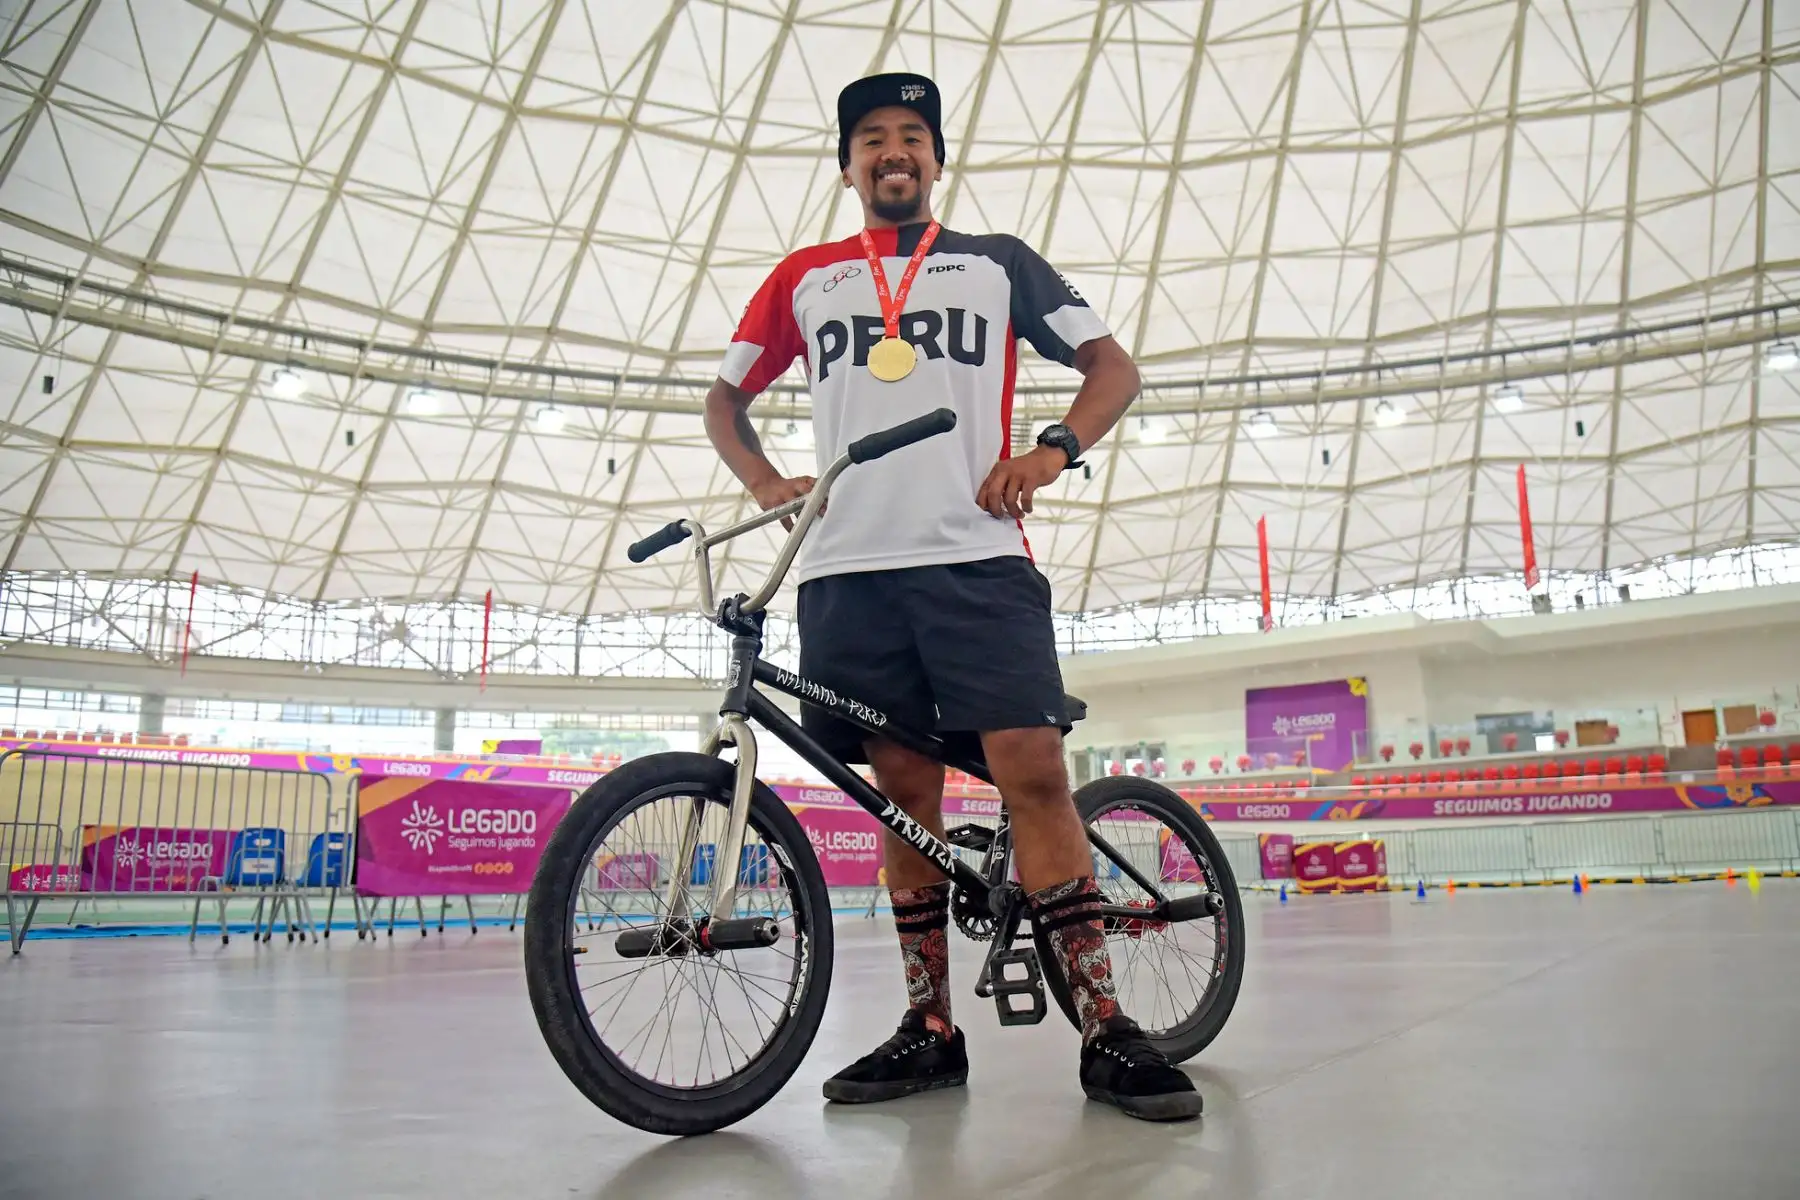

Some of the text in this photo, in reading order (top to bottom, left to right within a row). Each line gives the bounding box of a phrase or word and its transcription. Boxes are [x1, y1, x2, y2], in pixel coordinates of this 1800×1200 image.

[927, 264, 966, 275] FDPC
[816, 307, 988, 383] PERU
[383, 762, 432, 777] LEGADO
[547, 769, 607, 785] SEGUIM
[1237, 804, 1290, 819] LEGADO
[1434, 791, 1612, 815] SEGUIMOS JUGANDO
[447, 808, 537, 834] LEGADO
[448, 835, 497, 852] Seguimos
[826, 831, 877, 850] LEGADO
